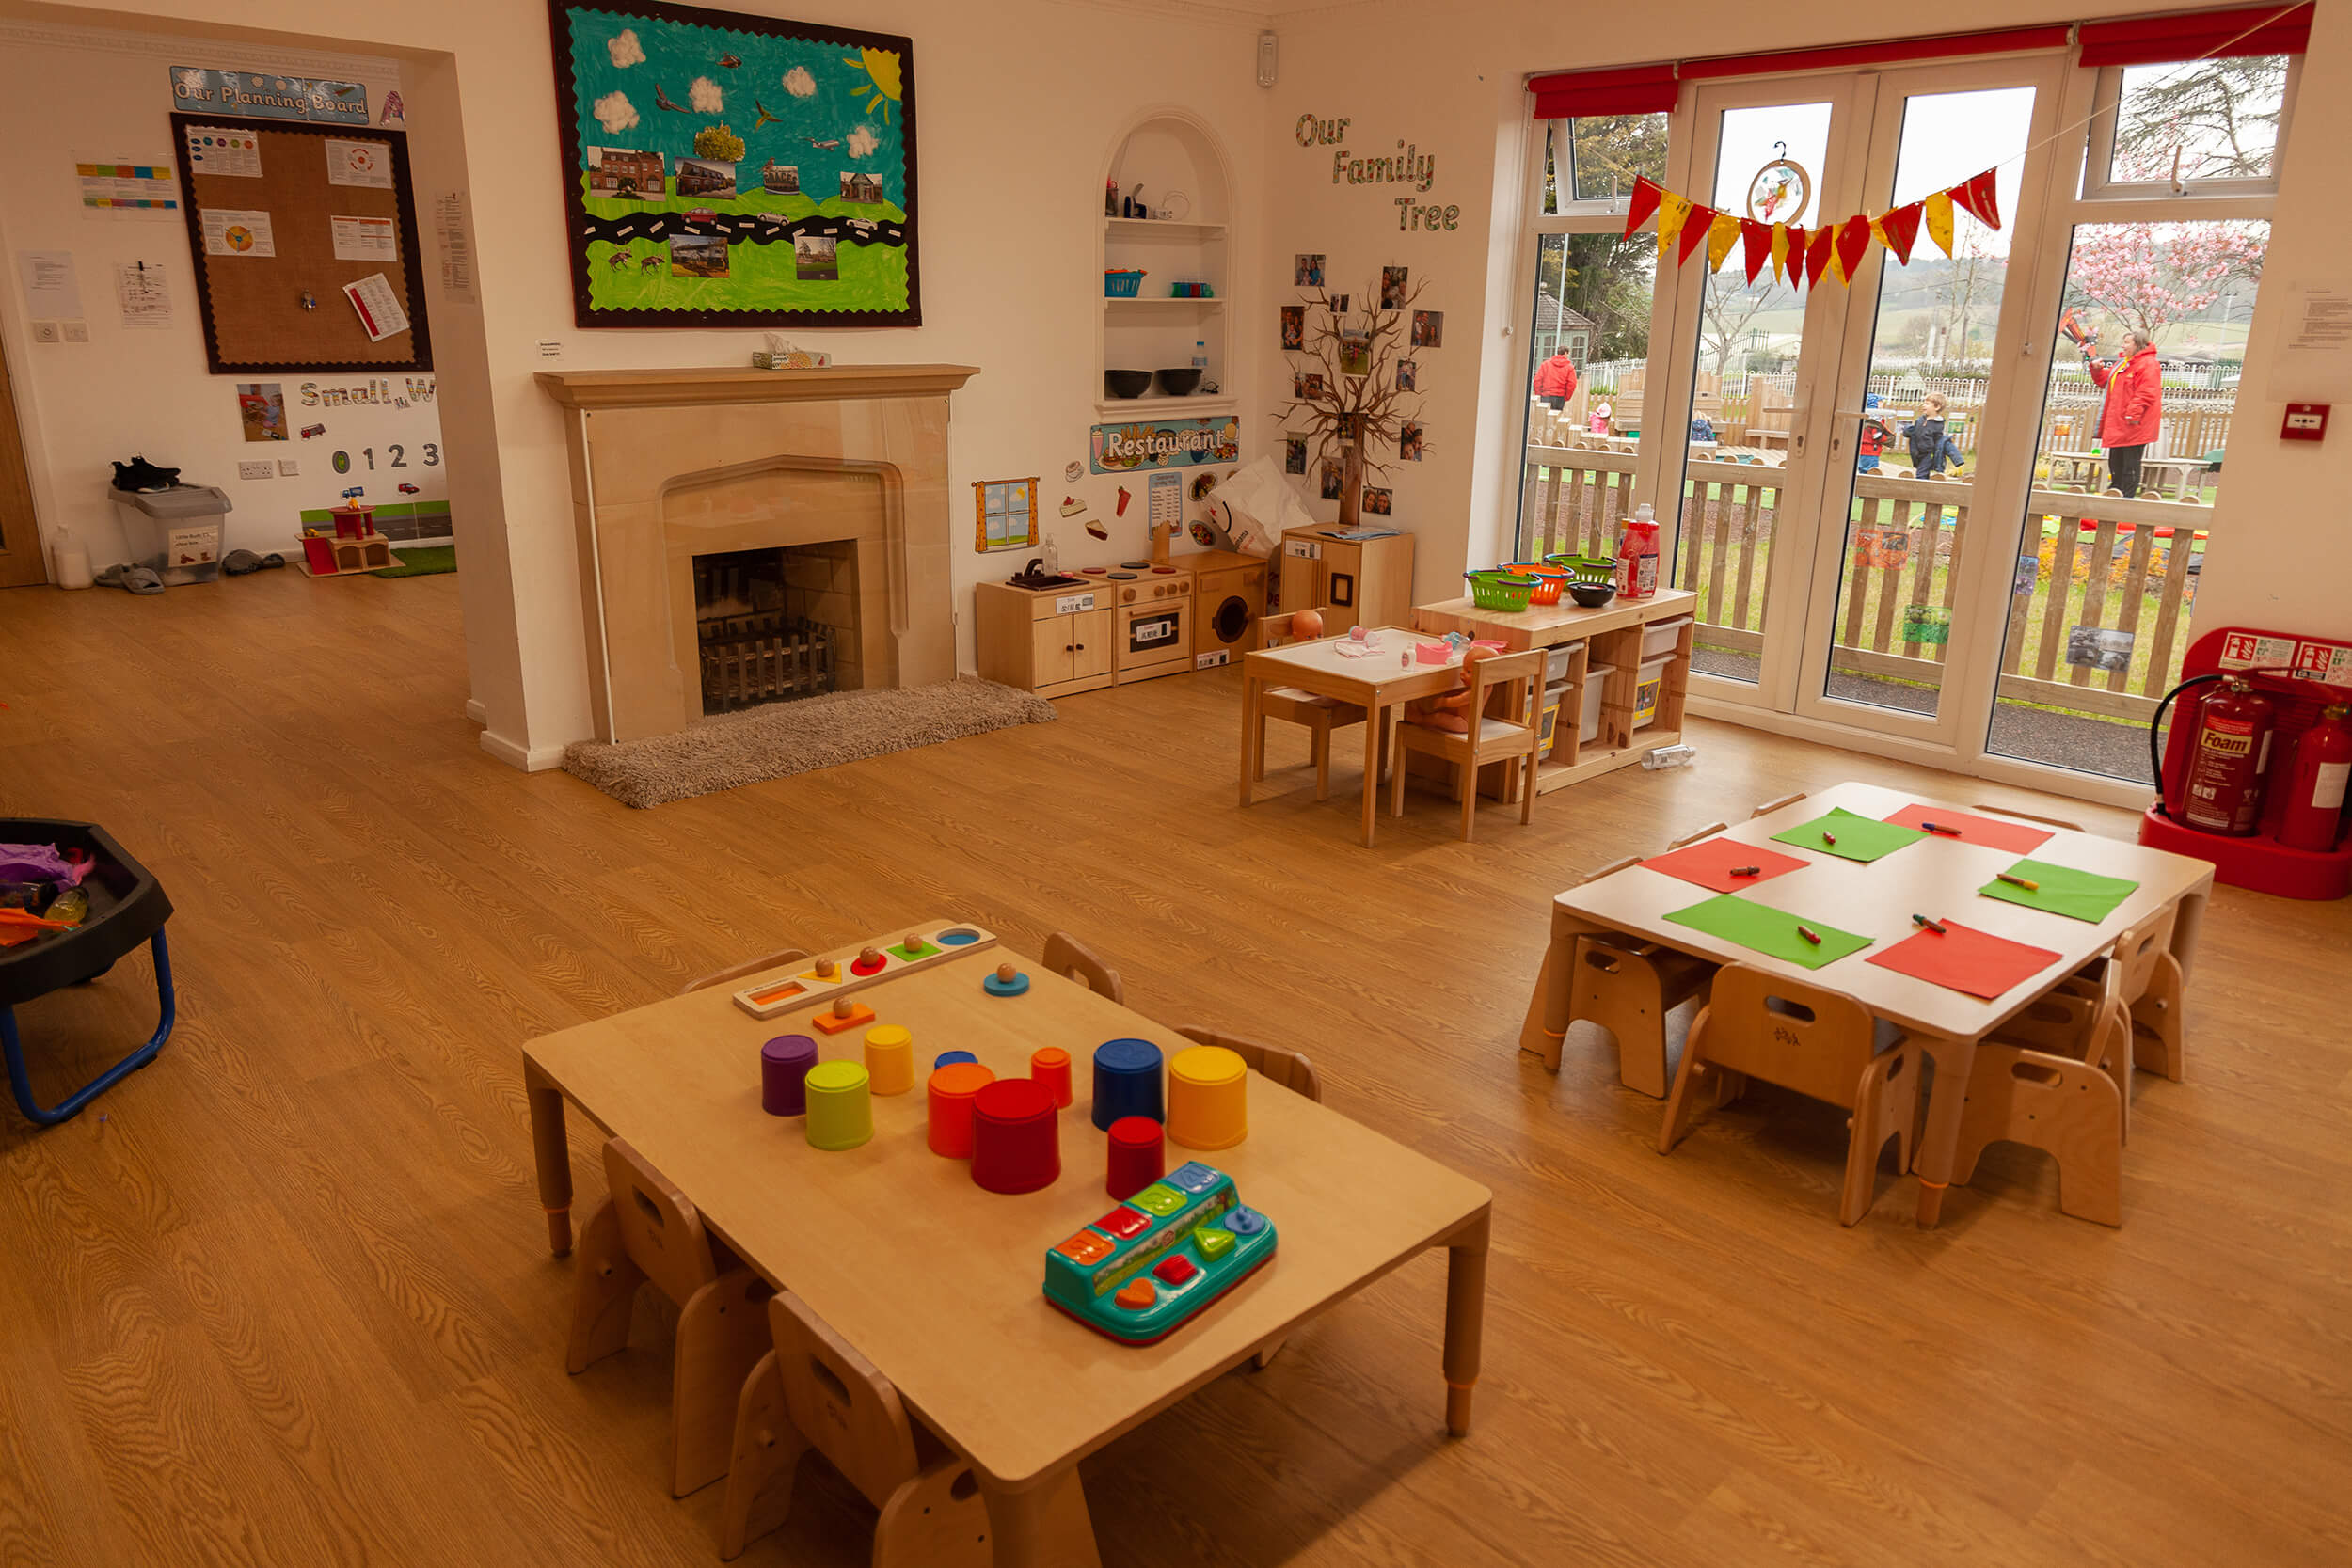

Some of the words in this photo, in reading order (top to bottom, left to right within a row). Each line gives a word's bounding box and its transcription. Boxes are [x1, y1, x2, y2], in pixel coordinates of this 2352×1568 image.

[175, 83, 214, 102] Our
[220, 87, 307, 114] Planning
[310, 94, 368, 115] Board
[1296, 113, 1351, 148] Our
[1332, 139, 1435, 193] Family
[1394, 198, 1460, 231] Tree
[300, 377, 392, 407] Small
[331, 450, 351, 475] 0
[362, 447, 375, 470] 1
[388, 444, 407, 467] 2
[422, 443, 440, 467] 3
[1108, 429, 1225, 459] Restaurant
[2204, 732, 2248, 752] Foam
